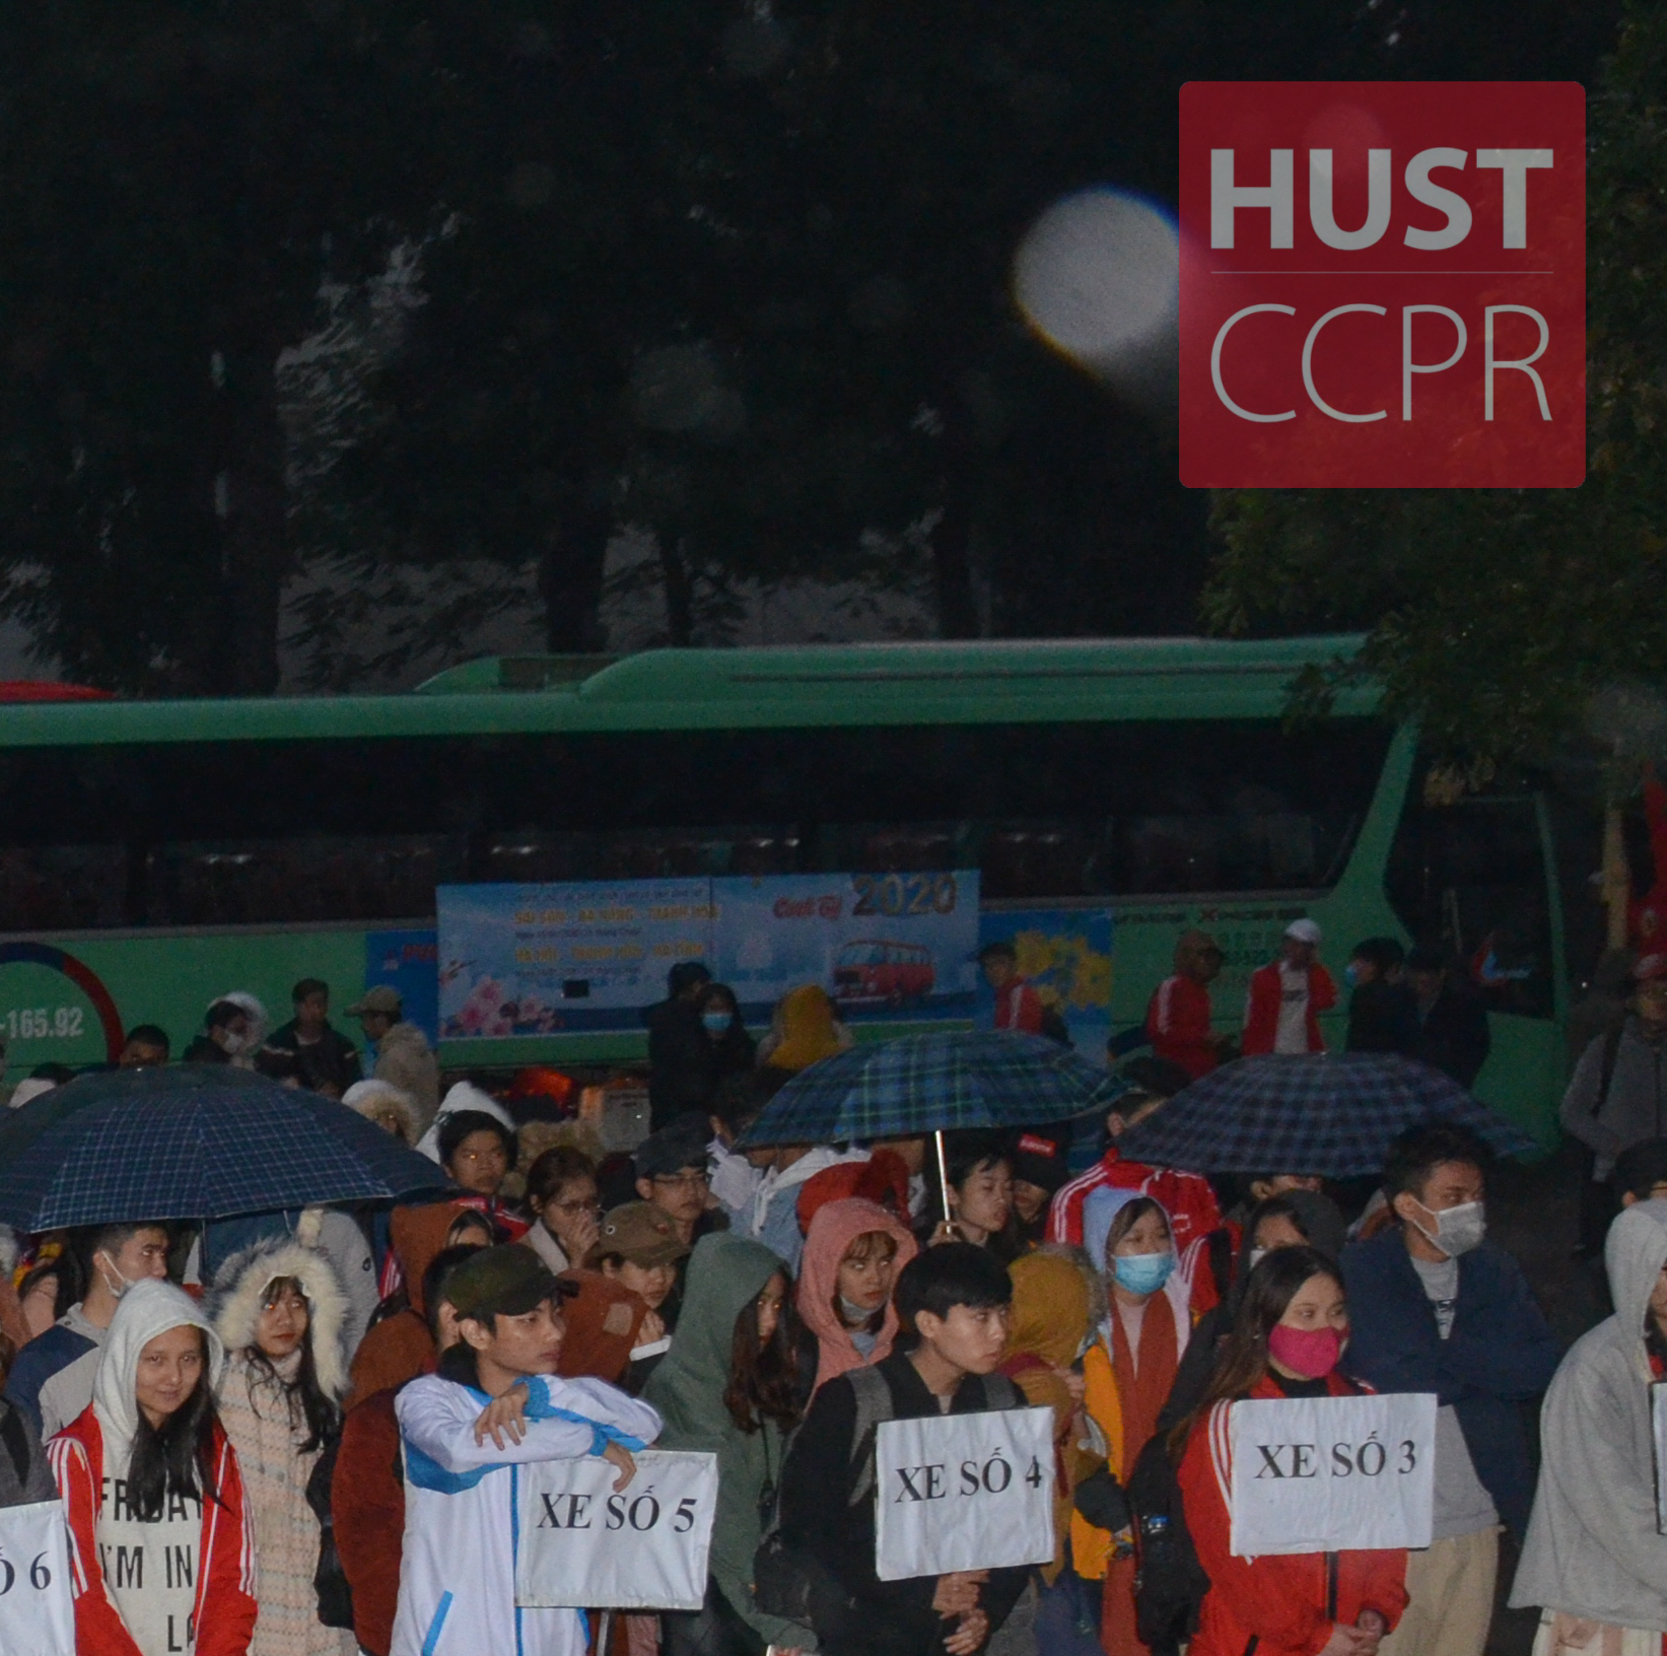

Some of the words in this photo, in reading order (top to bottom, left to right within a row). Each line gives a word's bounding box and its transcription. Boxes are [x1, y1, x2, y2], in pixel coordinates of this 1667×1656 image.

[853, 873, 957, 916] 2020
[896, 1464, 946, 1503] XE
[960, 1447, 1012, 1497] SỐ
[1025, 1455, 1044, 1490] 4
[1256, 1444, 1316, 1479] XE
[1332, 1430, 1387, 1476] SỐ
[1398, 1439, 1417, 1475] 3
[536, 1492, 592, 1530] XE
[605, 1485, 660, 1532] SỐ
[673, 1498, 697, 1533] 5
[29, 1552, 51, 1591] 6
[166, 1544, 193, 1589] IN
